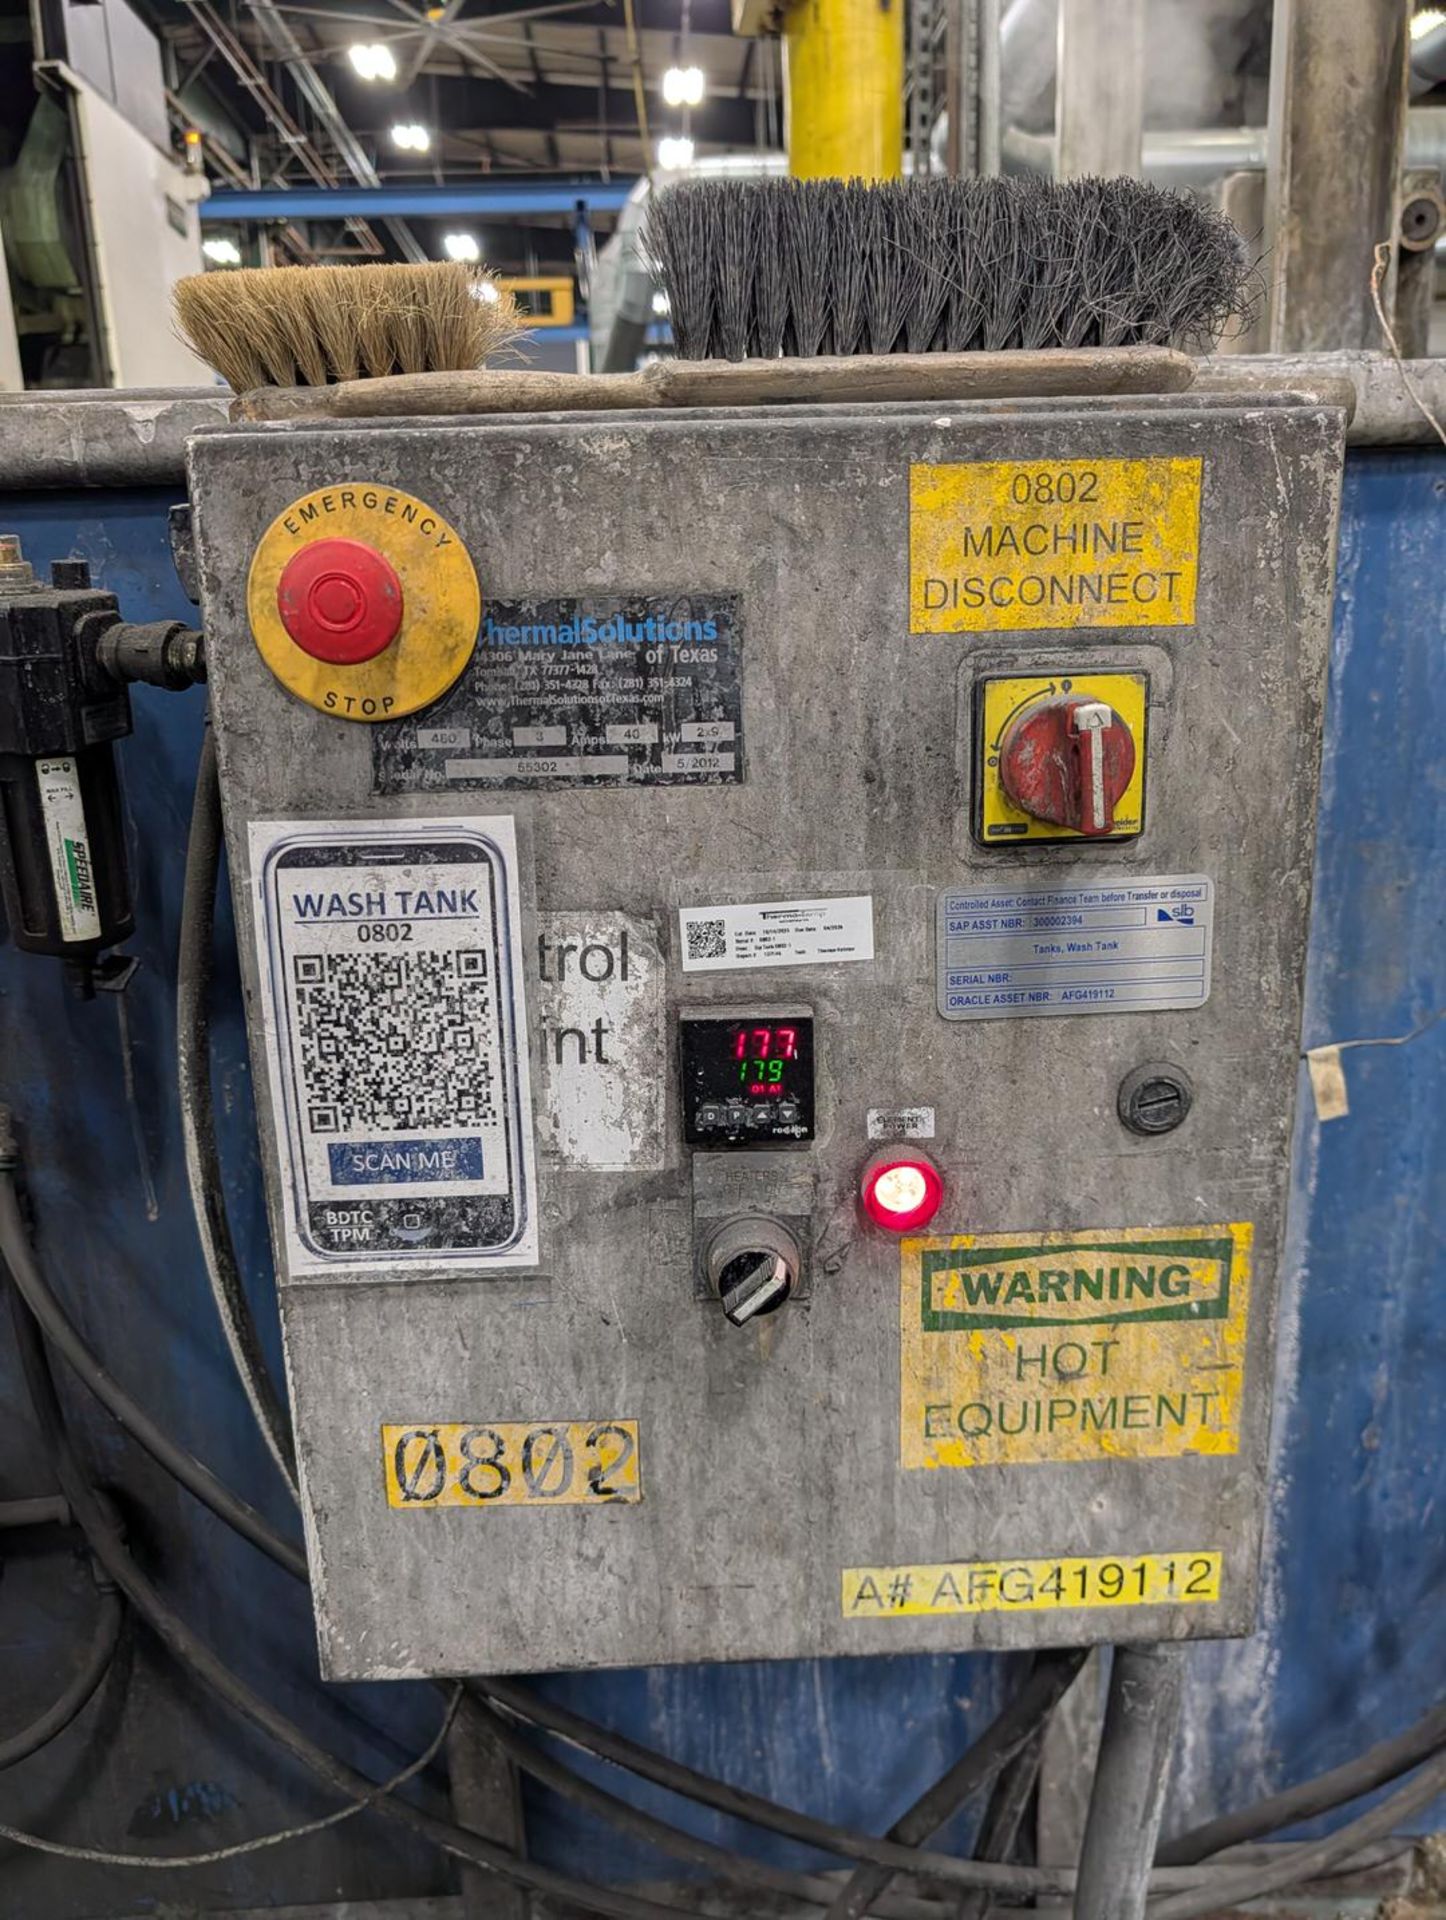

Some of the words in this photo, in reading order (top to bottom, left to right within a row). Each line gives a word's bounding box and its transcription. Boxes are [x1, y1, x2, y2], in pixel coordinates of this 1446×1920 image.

[1012, 471, 1097, 505] 0802
[283, 492, 452, 547] EMERGENCY
[963, 522, 1144, 557] MACHINE
[924, 572, 1182, 609] DISCONNECT
[478, 614, 718, 648] hermalSolutions
[518, 650, 556, 664] Mary
[561, 649, 594, 661] Jane
[645, 645, 664, 664] of
[672, 644, 718, 664] Texas
[324, 692, 395, 715] STOP
[536, 731, 544, 742] 3
[677, 757, 720, 769] 5/2012
[71, 840, 95, 913] SPEEDAIRE
[293, 891, 389, 919] WASH
[394, 888, 479, 916] TANK
[950, 898, 989, 910] Controlled
[1079, 893, 1100, 904] Team
[1102, 891, 1126, 903] before
[1127, 889, 1158, 902] Transfer
[1160, 890, 1169, 899] or
[1170, 888, 1202, 900] disposal
[357, 922, 414, 943] 0802
[949, 921, 970, 932] SAP
[972, 919, 997, 930] ASST
[1001, 917, 1025, 929] NBR:
[538, 931, 629, 982] trol
[1033, 943, 1064, 955] Tanks,
[1067, 942, 1093, 953] Wash
[1096, 940, 1119, 951] Tank
[950, 974, 986, 986] SERIAL
[988, 973, 1013, 984] NBR:
[950, 994, 990, 1006] ORACLE
[993, 992, 1025, 1004] ASSET
[1061, 988, 1115, 1001] AFG419112
[737, 1029, 795, 1058] 177
[740, 1060, 783, 1082] 179
[352, 1150, 412, 1172] SCAN
[419, 1150, 455, 1169] ME
[326, 1211, 374, 1226] BDTC
[330, 1227, 371, 1242] TPM
[961, 1264, 1191, 1306] WARNING
[1016, 1341, 1119, 1381] HOT
[923, 1392, 1221, 1439] EQUIPMENT
[395, 1424, 638, 1501] 0802
[852, 1572, 914, 1610] A#
[930, 1558, 1212, 1604] AFG419112
